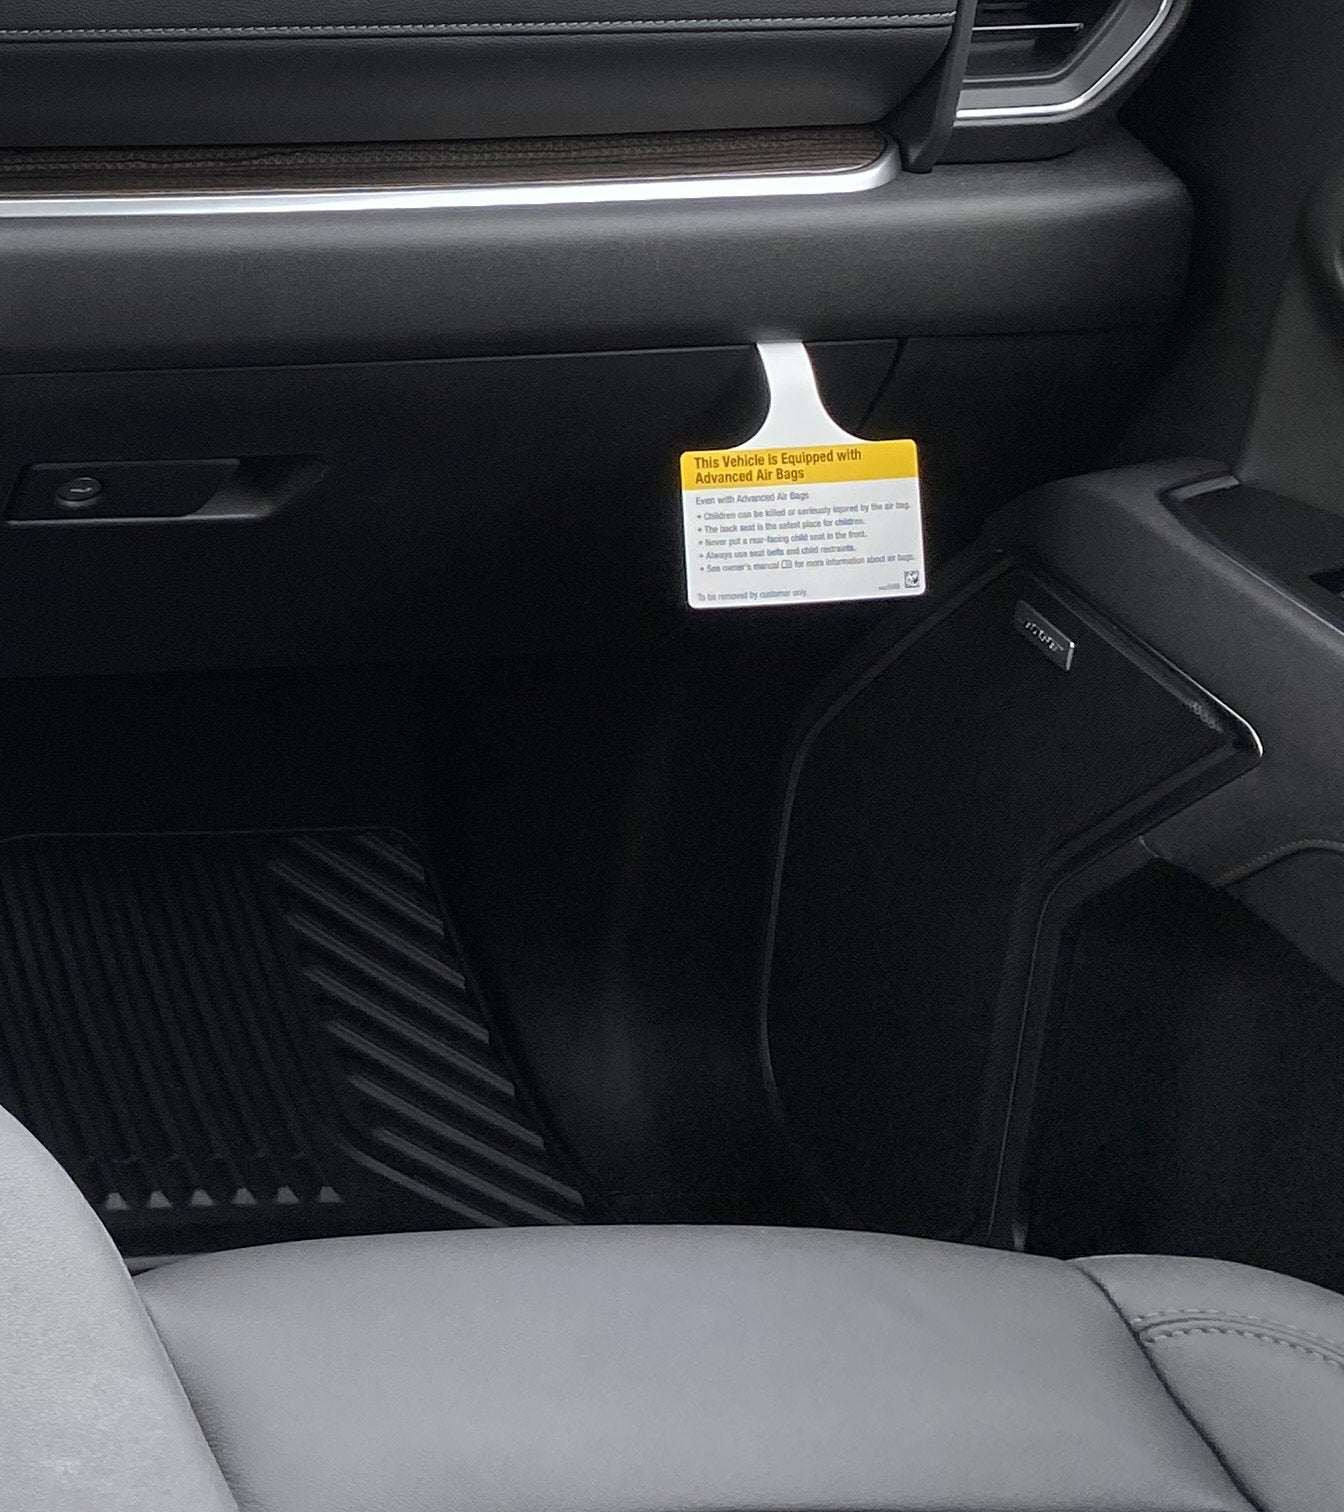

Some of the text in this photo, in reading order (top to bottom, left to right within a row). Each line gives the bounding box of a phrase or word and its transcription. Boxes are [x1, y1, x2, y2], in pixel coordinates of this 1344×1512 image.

[694, 448, 861, 469] This Vehicle is Equipped with
[695, 467, 804, 484] Advanced Air Bags
[696, 491, 809, 506] Even with Advanced Air Bags
[753, 510, 763, 518] be
